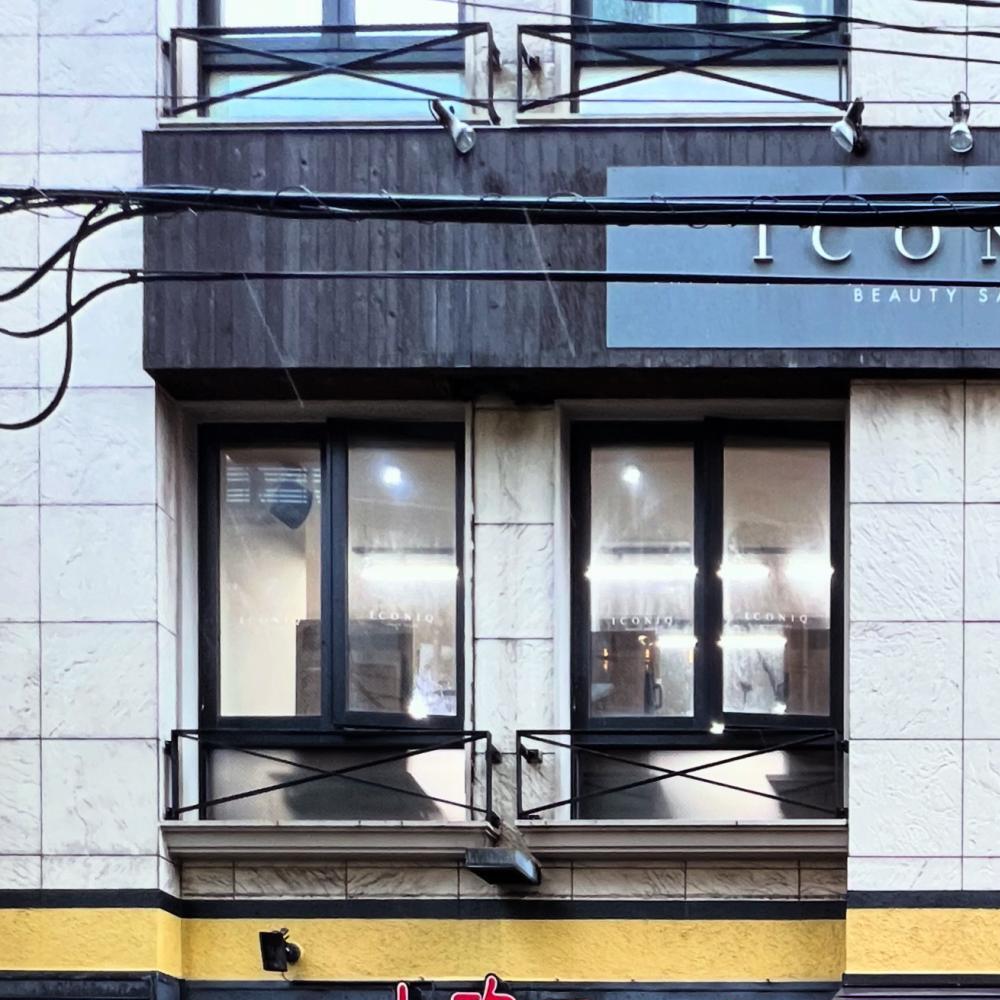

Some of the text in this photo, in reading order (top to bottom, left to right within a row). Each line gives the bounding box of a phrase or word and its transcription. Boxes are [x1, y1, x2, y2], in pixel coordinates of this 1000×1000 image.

[853, 288, 957, 303] BEAUTY
[369, 610, 435, 624] ICONIQ
[611, 615, 673, 626] ICONIQ
[744, 611, 808, 624] ICONIQ
